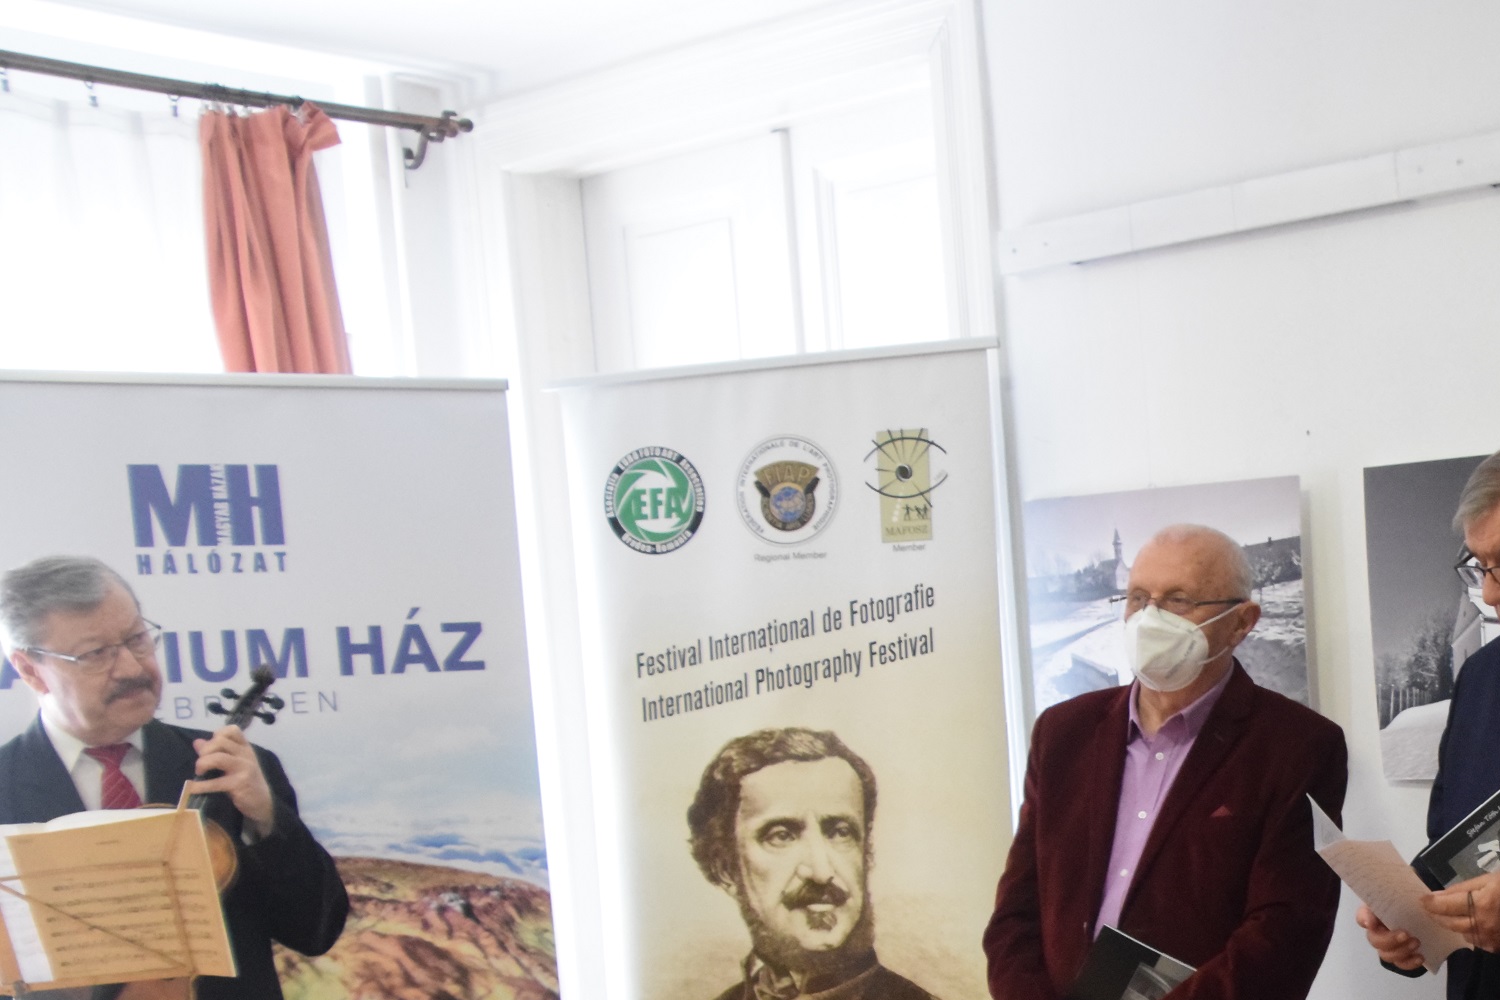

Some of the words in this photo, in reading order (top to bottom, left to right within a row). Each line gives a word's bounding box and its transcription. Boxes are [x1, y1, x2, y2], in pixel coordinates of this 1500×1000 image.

[764, 464, 811, 485] FIAP
[127, 464, 285, 547] MH
[636, 487, 681, 520] EFA
[136, 549, 287, 575] HÁLÓZAT
[754, 553, 790, 563] Regional
[793, 551, 827, 560] Member
[893, 543, 926, 552] Member
[336, 607, 486, 676] HÁZ
[636, 638, 702, 679] Festival
[822, 606, 842, 633] de
[849, 583, 935, 627] Fotografie
[641, 672, 749, 722] International
[755, 648, 862, 695] Photography
[869, 627, 934, 668] Festival
